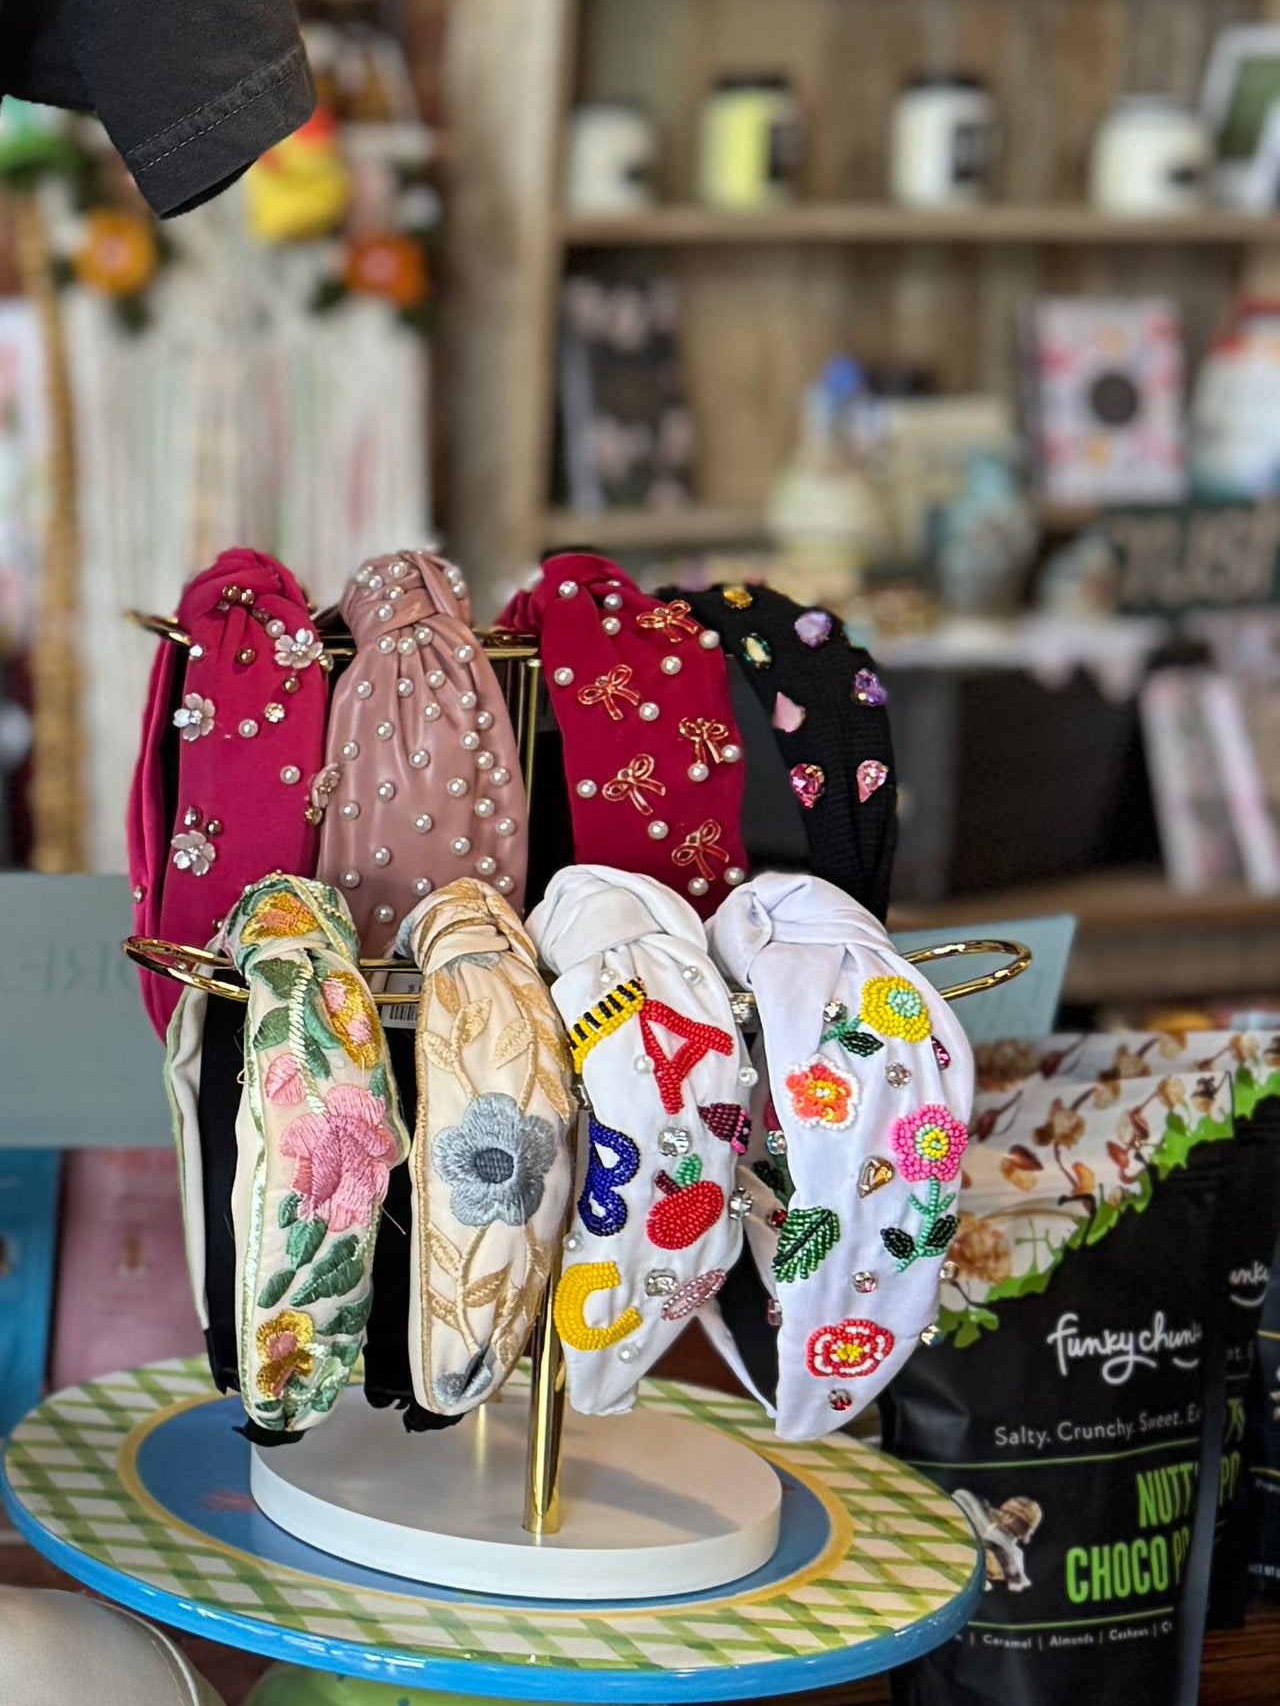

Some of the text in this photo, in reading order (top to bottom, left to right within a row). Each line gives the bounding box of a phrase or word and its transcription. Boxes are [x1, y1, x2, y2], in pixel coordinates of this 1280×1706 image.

[1046, 1312, 1158, 1386] funky
[994, 1426, 1051, 1449] Salty.
[1057, 1417, 1137, 1443] Crunchy.
[1136, 1461, 1199, 1529] NUTT
[1065, 1535, 1170, 1604] CHOCO
